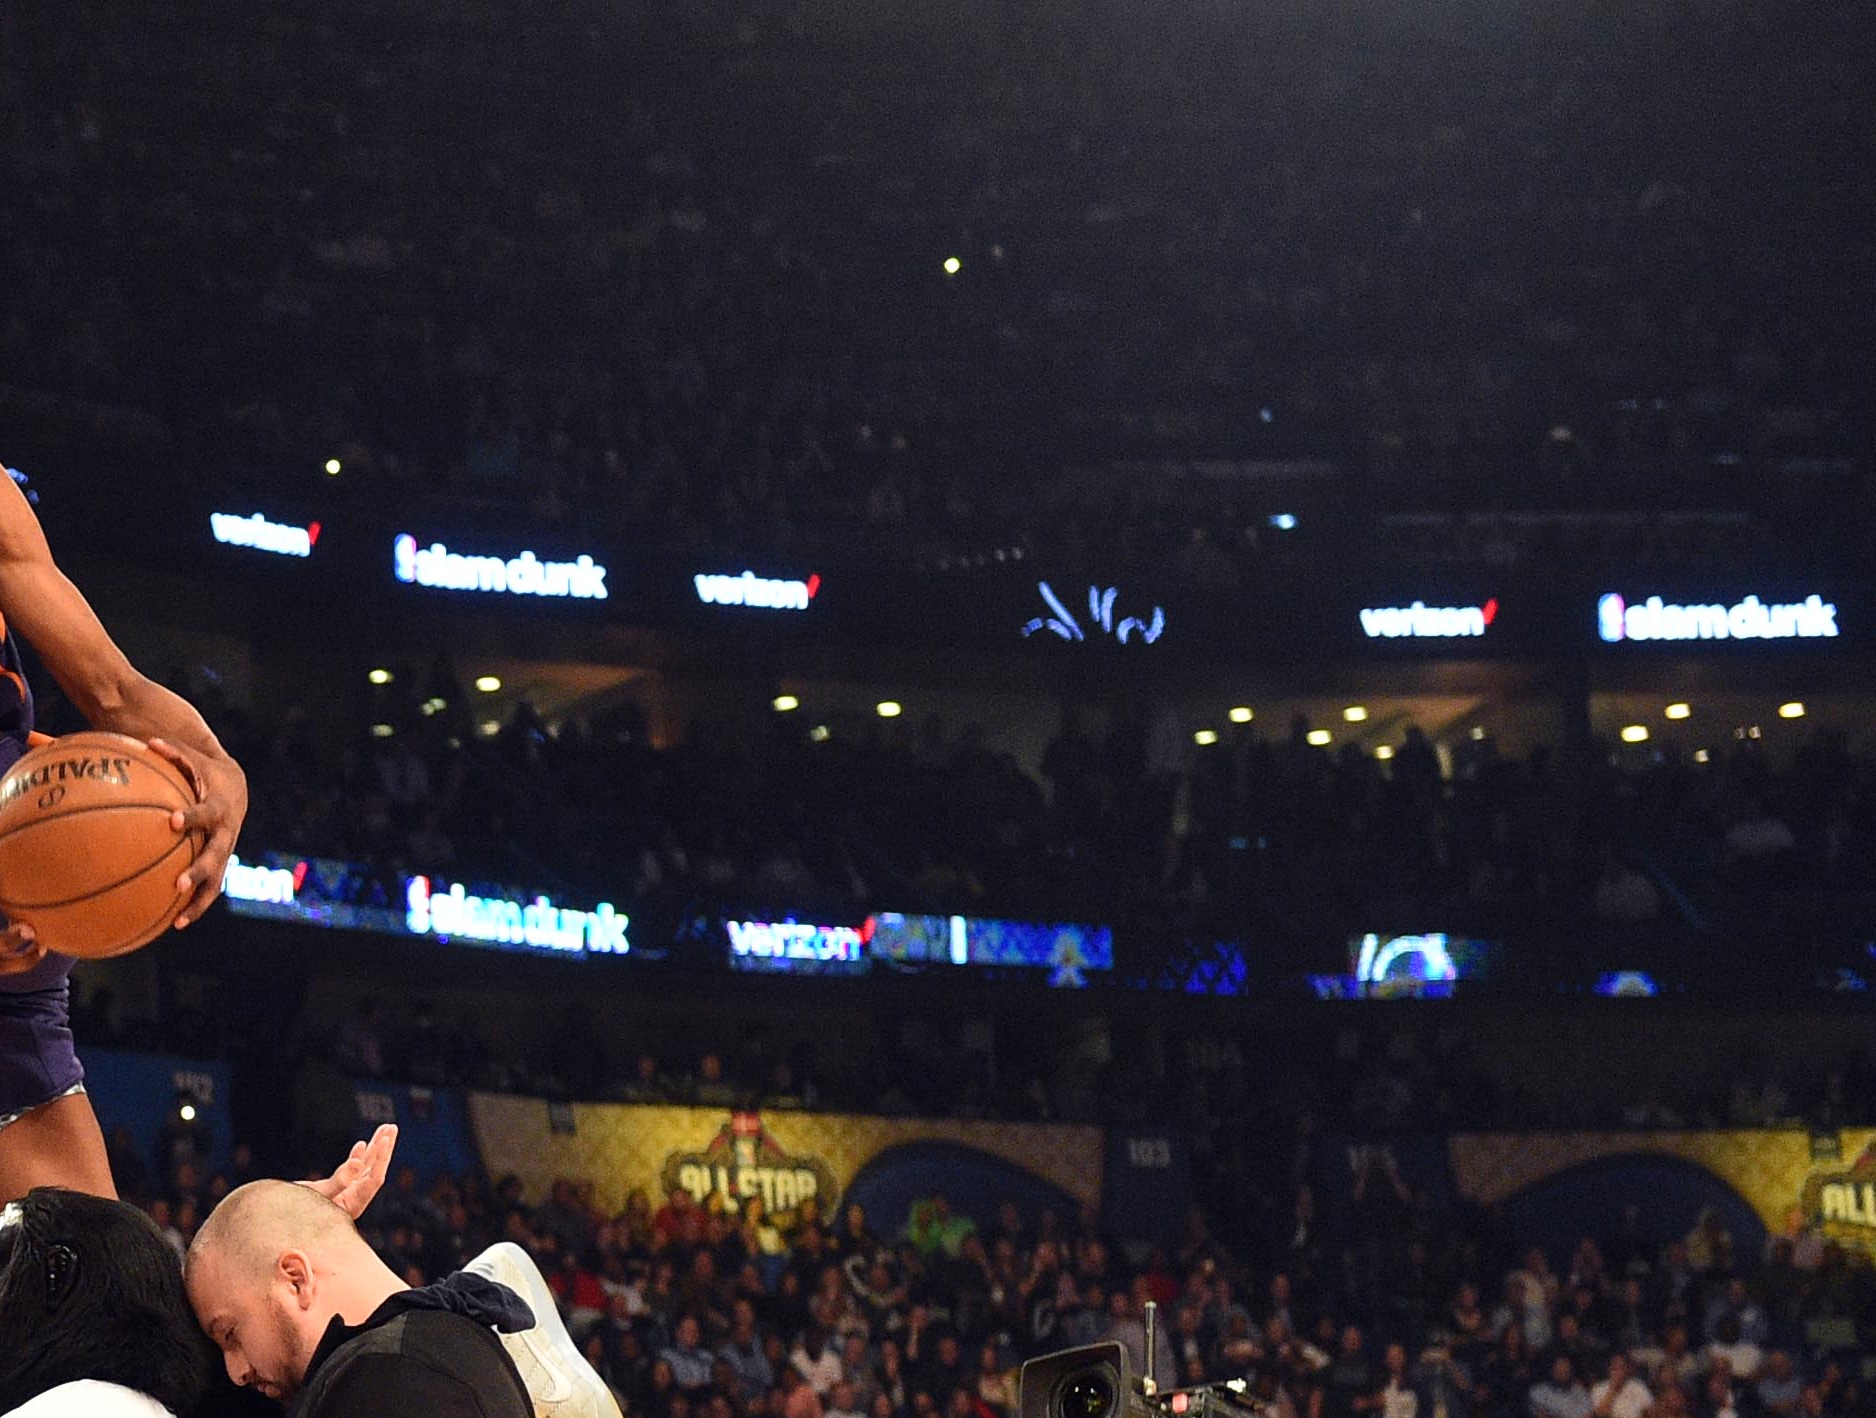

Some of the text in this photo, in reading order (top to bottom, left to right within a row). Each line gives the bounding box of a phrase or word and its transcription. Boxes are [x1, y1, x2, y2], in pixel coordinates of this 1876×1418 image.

[693, 570, 808, 609] verizon
[1360, 601, 1484, 637] verizon
[727, 917, 862, 962] verizon
